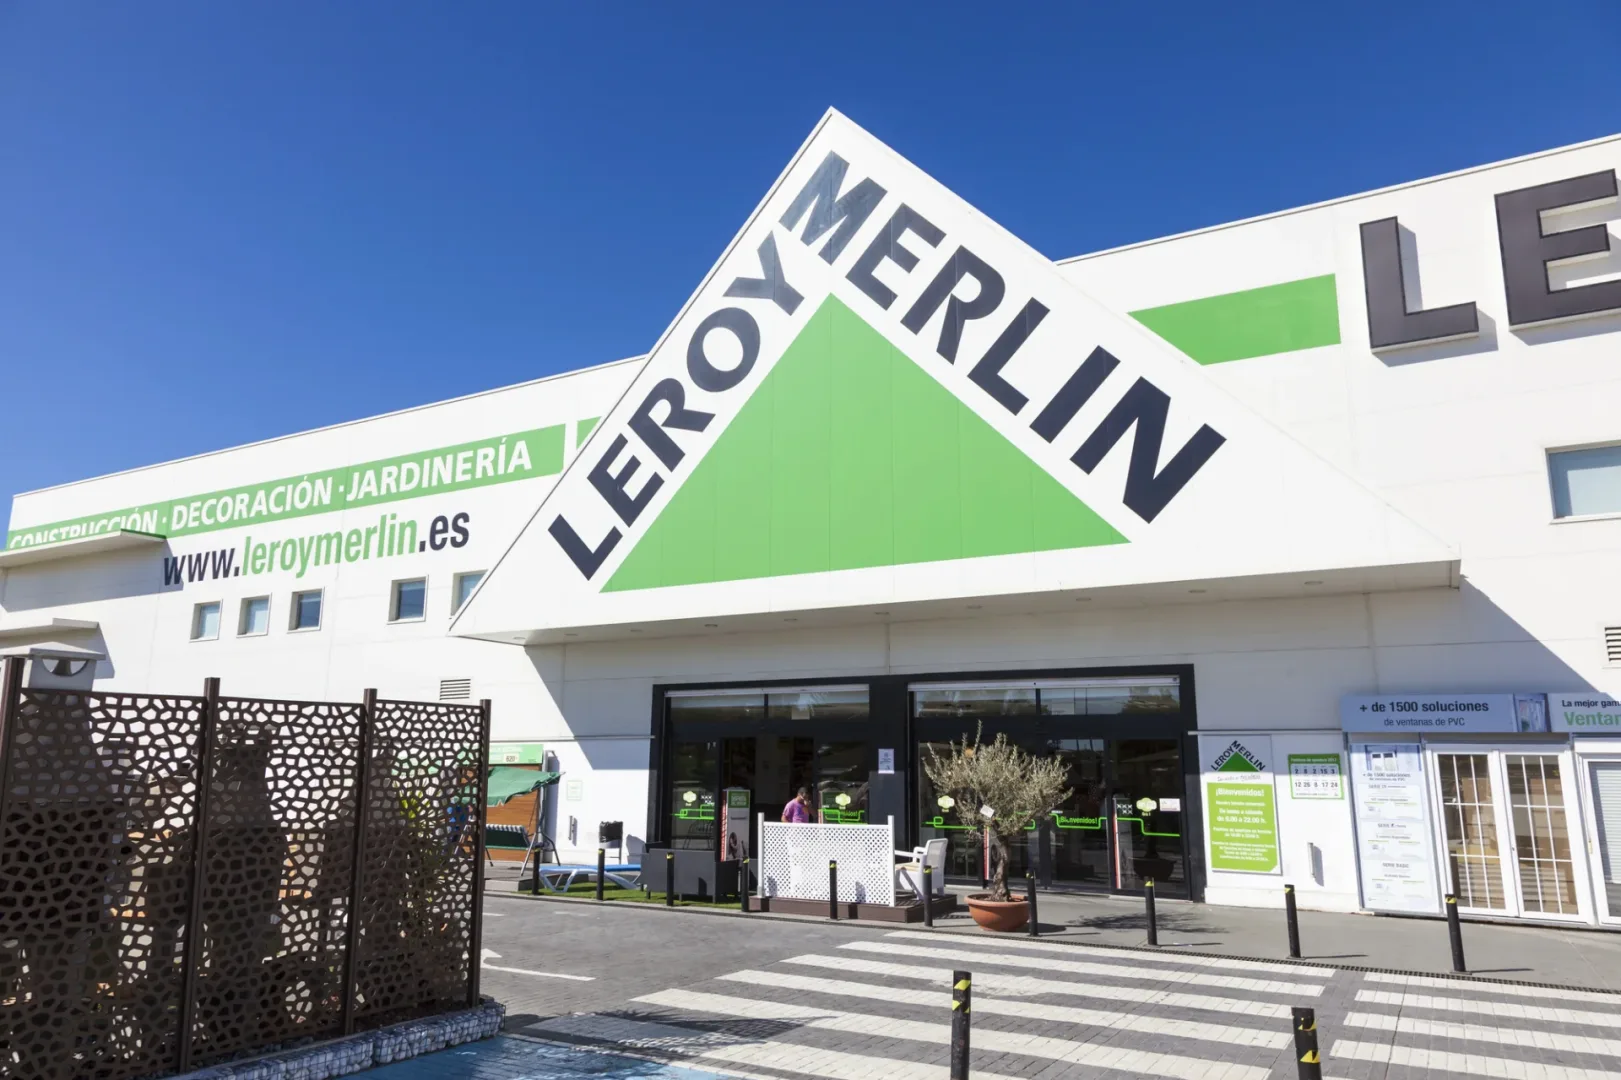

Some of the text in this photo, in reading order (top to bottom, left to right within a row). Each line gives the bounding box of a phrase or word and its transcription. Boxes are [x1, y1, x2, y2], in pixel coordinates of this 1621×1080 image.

[548, 150, 1228, 582] LEROY MERLIN
[170, 475, 334, 531] DECORACIÓN
[345, 437, 533, 502] JARDINERÍA
[163, 511, 470, 587] www.leroymerlin.es
[1371, 702, 1386, 713] de
[1389, 701, 1418, 712] 1500
[1421, 701, 1489, 712] soluciones
[1561, 699, 1572, 707] La
[1574, 699, 1598, 708] mejor
[1383, 717, 1465, 726] de ventanas de PVC
[1210, 740, 1266, 771] LEROY MERLIN
